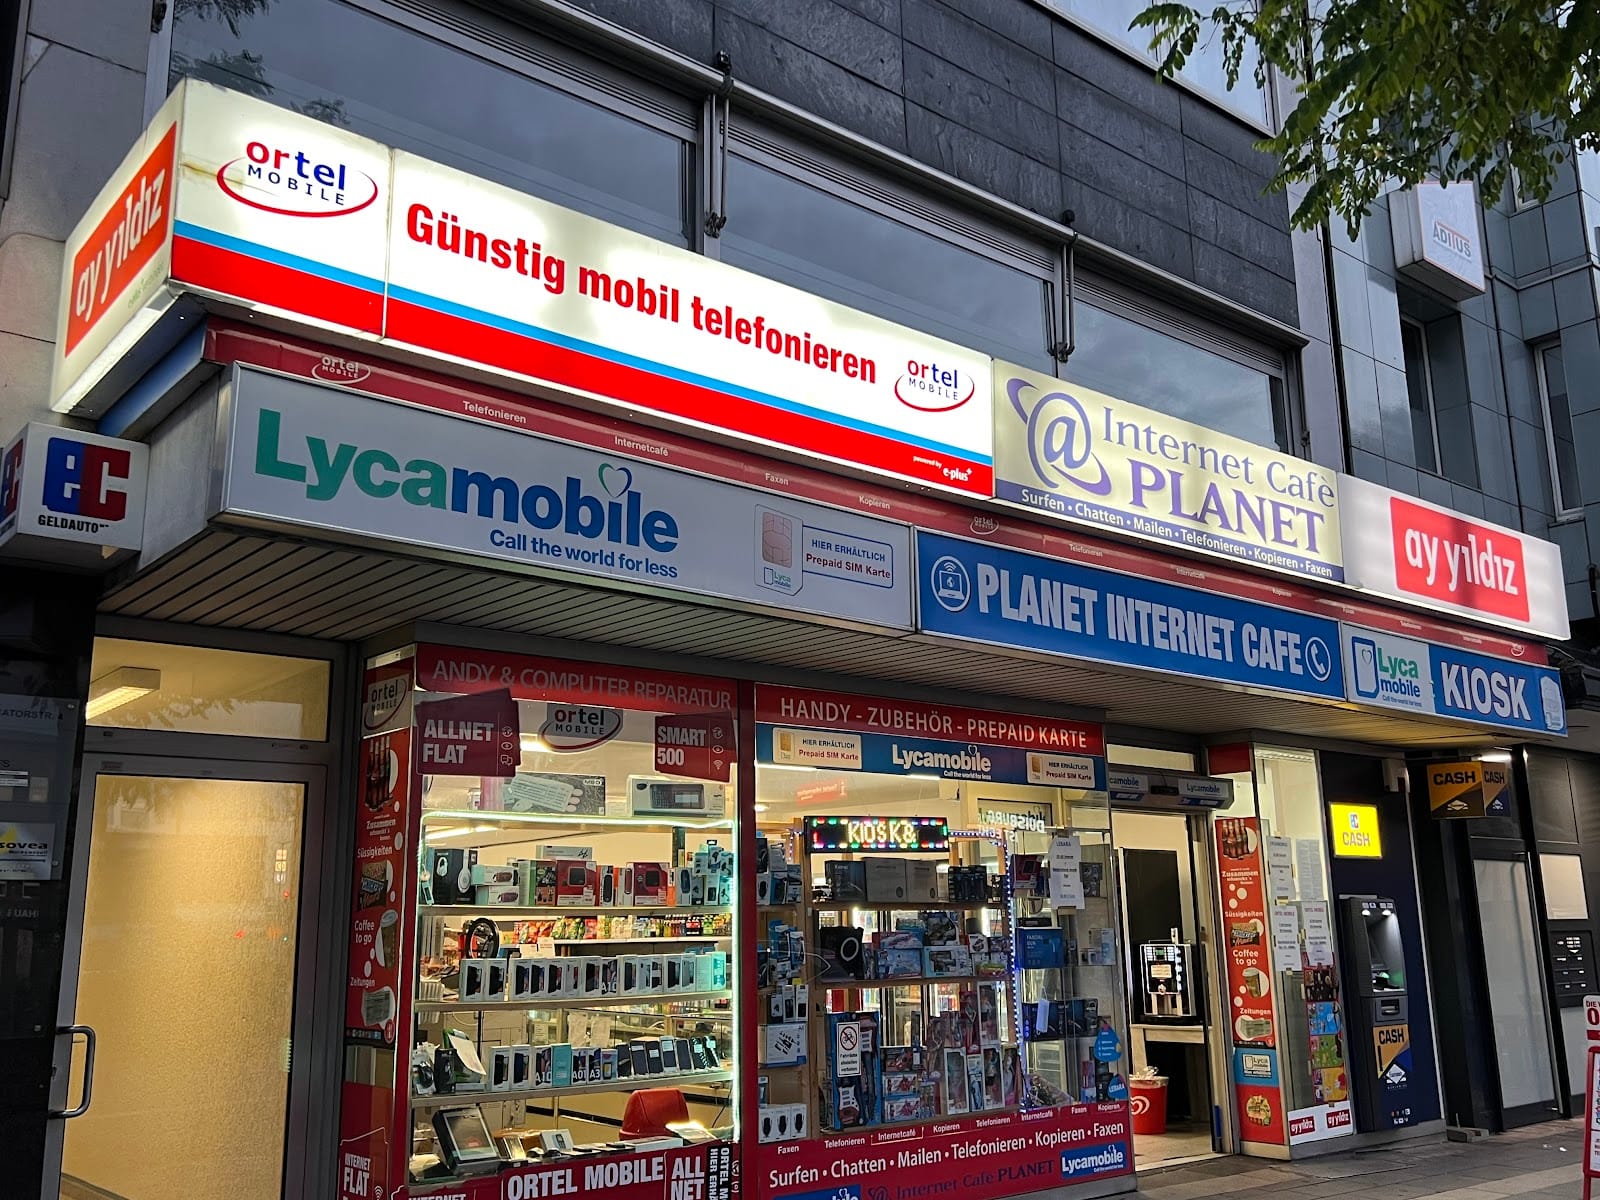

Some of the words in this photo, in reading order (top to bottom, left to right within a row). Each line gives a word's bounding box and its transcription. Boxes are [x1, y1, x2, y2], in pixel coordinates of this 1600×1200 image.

[246, 141, 346, 191] ortel
[248, 164, 345, 206] MOBILE
[1433, 221, 1471, 258] ADITUS
[76, 249, 102, 323] ay
[407, 203, 565, 295] Günstig
[579, 266, 679, 323] mobil
[691, 296, 876, 384] telefonieren
[321, 355, 360, 374] ortel
[321, 366, 359, 379] MOBILE
[907, 360, 958, 389] ortel
[909, 377, 959, 401] MOBILE
[463, 400, 527, 425] Telefonieren
[614, 435, 669, 457] Internetcafé
[1103, 406, 1254, 485] Internet
[255, 407, 679, 554] Lycamobile
[765, 472, 789, 487] Faxen
[859, 494, 891, 511] Kopieren
[1127, 458, 1326, 554] PLANET
[1021, 488, 1065, 512] Surfen
[1075, 502, 1124, 526] Chatten
[1133, 517, 1173, 538] Mailen
[1180, 529, 1247, 556] Telefonieren
[1254, 547, 1299, 570] Kopieren
[1305, 560, 1333, 578] Faxen
[489, 528, 527, 552] Call
[531, 537, 562, 558] the
[565, 546, 615, 569] world
[618, 553, 643, 573] for
[645, 557, 678, 578] less
[811, 538, 833, 553] HIER
[834, 543, 886, 562] ERHÄLTLICH
[1404, 527, 1438, 586] ay
[774, 571, 791, 583] Lyca
[805, 552, 843, 571] Prepaid
[845, 561, 863, 574] SIM
[865, 565, 891, 580] Karte
[976, 562, 1098, 636] PLANET
[1106, 592, 1235, 664] INTERNET
[1241, 622, 1304, 676] CAFE
[1377, 647, 1419, 680] Lyca
[371, 679, 398, 704] ortel
[432, 659, 496, 684] ANDY
[501, 666, 516, 686] &
[520, 668, 630, 697] COMPUTER
[634, 681, 732, 710] REPARATUR
[1380, 676, 1420, 698] mobile
[1440, 661, 1532, 722] KIOSK
[371, 698, 398, 713] MOBILE
[555, 707, 605, 726] ortel
[424, 719, 494, 742] ALLNET
[555, 723, 605, 736] MOBILE
[780, 697, 852, 723] HANDY
[867, 707, 953, 735] ZUBEHÖR
[967, 718, 1035, 743] PREPAID
[1039, 727, 1088, 749] KARTE
[657, 726, 706, 747] SMART
[802, 738, 817, 747] HIER
[818, 739, 855, 750] ERHÄLTLICH
[422, 743, 468, 765] FLAT
[657, 747, 684, 766] 500
[798, 749, 825, 760] Prepaid
[826, 750, 839, 760] SIM
[840, 752, 859, 761] Karte
[892, 744, 991, 773] Lycamobile
[1046, 770, 1066, 780] Prepaid
[1067, 771, 1077, 780] SIM
[1078, 772, 1092, 781] Karte
[1109, 776, 1140, 787] camobile
[1433, 771, 1476, 786] CASH
[1483, 769, 1505, 785] CASH
[1186, 783, 1220, 794] Lycamobile
[1342, 831, 1371, 848] CASH
[354, 919, 375, 931] Coffee
[1224, 910, 1263, 919] Süssigkeiten
[355, 934, 362, 943] to
[363, 935, 372, 945] go
[1232, 949, 1259, 958] Coffee
[350, 977, 376, 988] Zeitungen
[1239, 1007, 1271, 1016] Zeitungen
[1378, 1029, 1405, 1045] CASH
[1021, 1110, 1054, 1122] Internetcafé
[1071, 1105, 1088, 1115] Faxen
[1097, 1102, 1121, 1112] Kopieren
[933, 1122, 960, 1134] Kopieren
[976, 1115, 1011, 1128] Telefonieren
[825, 1136, 865, 1149] Telefonieren
[878, 1128, 916, 1141] Internetcafé
[709, 1148, 719, 1173] HIER
[769, 1166, 819, 1188] Surfen
[831, 1157, 886, 1179] Chatten
[897, 1147, 942, 1169] Mailen
[951, 1136, 1026, 1160] Telefonieren
[1035, 1126, 1085, 1149] Kopieren
[1093, 1121, 1124, 1138] Faxen
[778, 1144, 800, 1155] Faxen
[1061, 1146, 1125, 1173] Lycamobile
[344, 1152, 371, 1171] INTERNET
[671, 1155, 705, 1180] ALL
[719, 1147, 730, 1185] ORTEL
[997, 1160, 1054, 1183] PLANET
[343, 1166, 370, 1197] FLAT
[506, 1170, 578, 1200] ORTEL
[584, 1156, 664, 1191] MOBILE
[670, 1178, 705, 1200] NET
